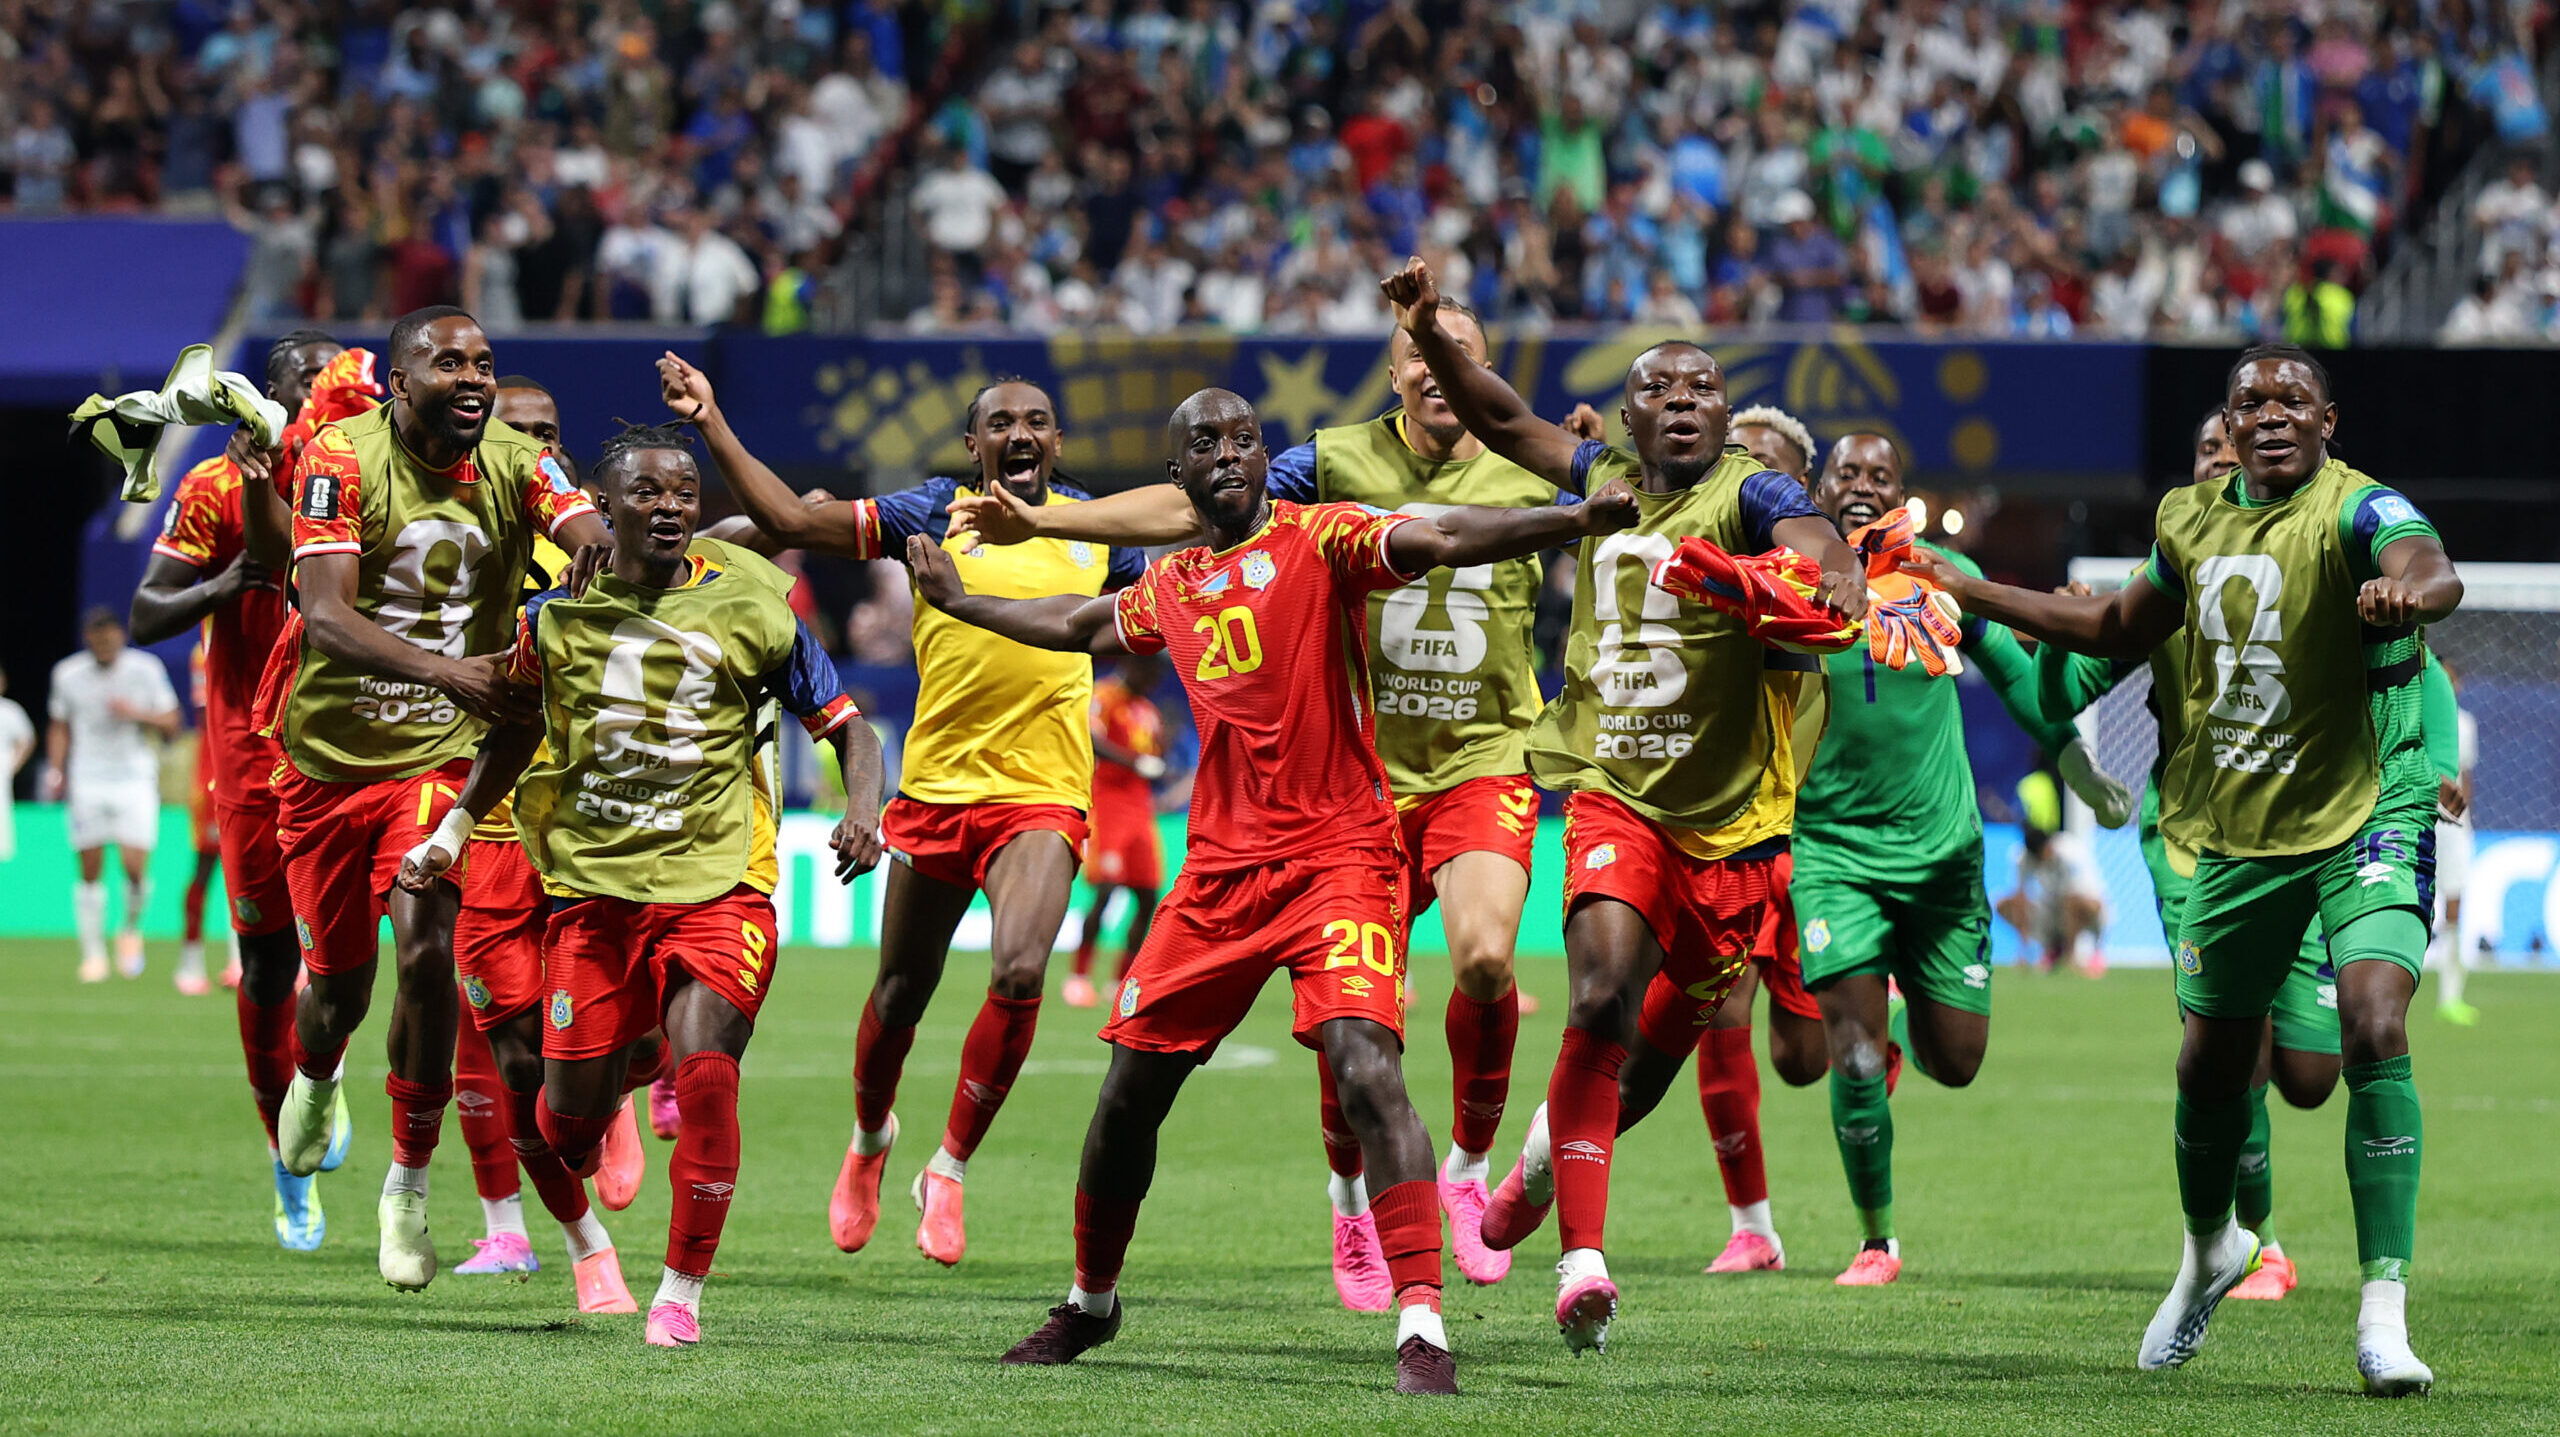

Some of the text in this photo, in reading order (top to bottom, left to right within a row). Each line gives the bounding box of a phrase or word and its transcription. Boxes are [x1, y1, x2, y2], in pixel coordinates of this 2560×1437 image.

[1193, 605, 1263, 682] 20
[1410, 639, 1458, 657] FIFA
[359, 676, 427, 699] WORLD
[1379, 672, 1482, 695] WORLD CUP
[1612, 671, 1659, 690] FIFA
[352, 696, 456, 723] 2026
[1377, 690, 1478, 720] 2026
[2223, 691, 2267, 711] FIFA
[1598, 712, 1692, 731] WORLD CUP
[1595, 732, 1694, 760] 2026
[2208, 726, 2297, 748] WORLD CUP
[622, 748, 671, 770] FIFA
[2212, 744, 2298, 775] 2026
[582, 772, 690, 806] WORLD CUP
[575, 791, 684, 832] 2026
[741, 920, 767, 974] 9
[1322, 918, 1394, 977] 20
[1341, 987, 1370, 998] umbro
[1563, 1153, 1606, 1165] umbro
[2366, 1147, 2415, 1158] umbro
